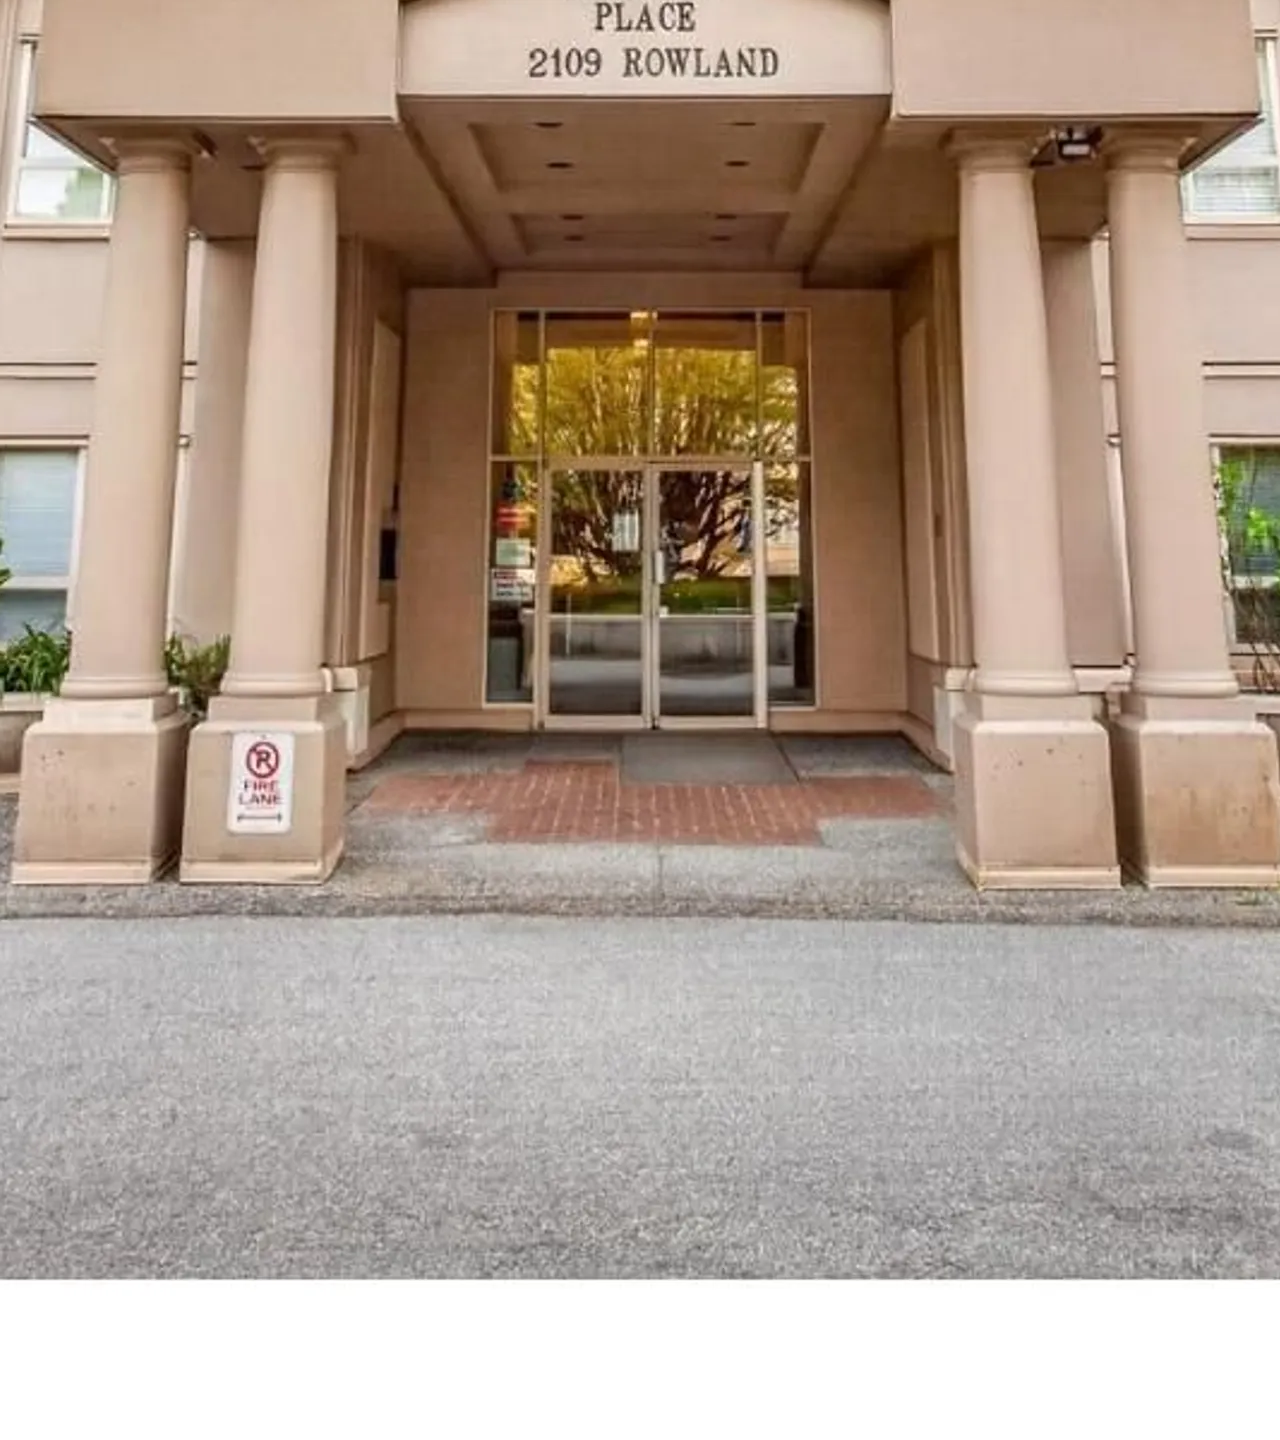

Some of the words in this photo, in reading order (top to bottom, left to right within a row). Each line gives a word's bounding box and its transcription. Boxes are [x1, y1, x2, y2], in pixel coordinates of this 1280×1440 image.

[594, 2, 697, 32] PLACE
[528, 47, 602, 78] 2109
[622, 48, 780, 78] ROWLAND
[242, 779, 279, 791] FIRE
[238, 792, 282, 805] LANE
